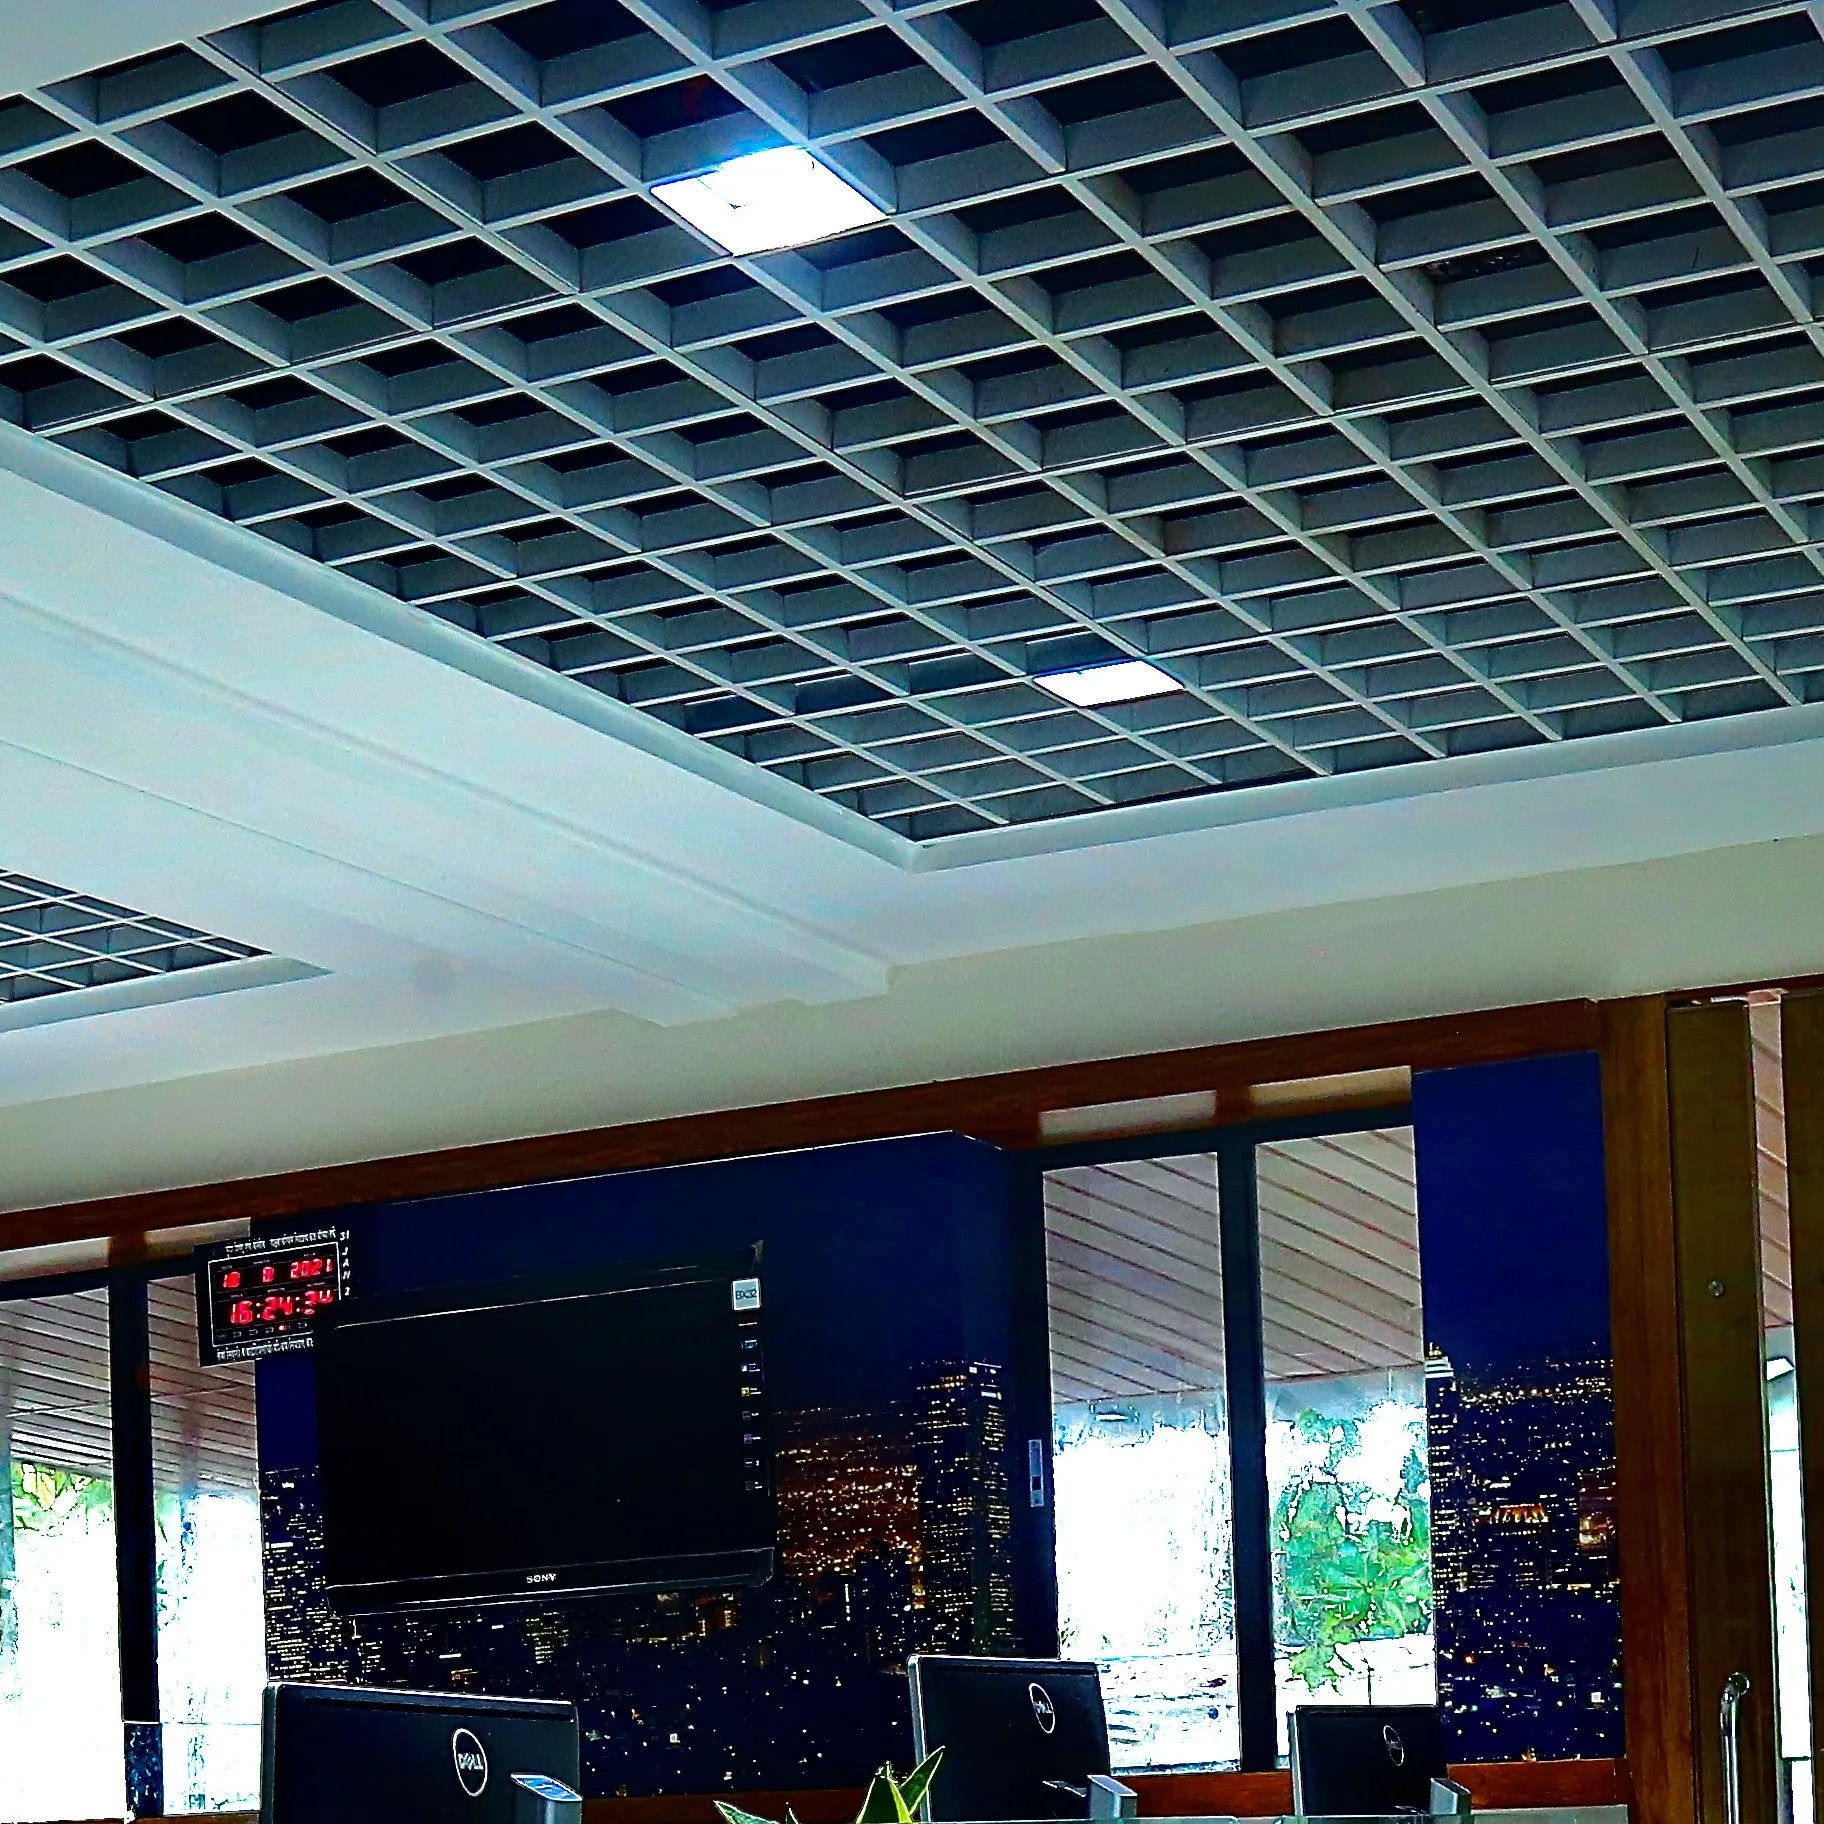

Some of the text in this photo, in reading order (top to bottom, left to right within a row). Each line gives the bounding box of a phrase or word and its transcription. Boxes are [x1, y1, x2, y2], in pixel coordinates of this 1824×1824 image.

[290, 1258, 332, 1278] 2021
[526, 1573, 557, 1584] SONY
[457, 1752, 484, 1770] DELL
